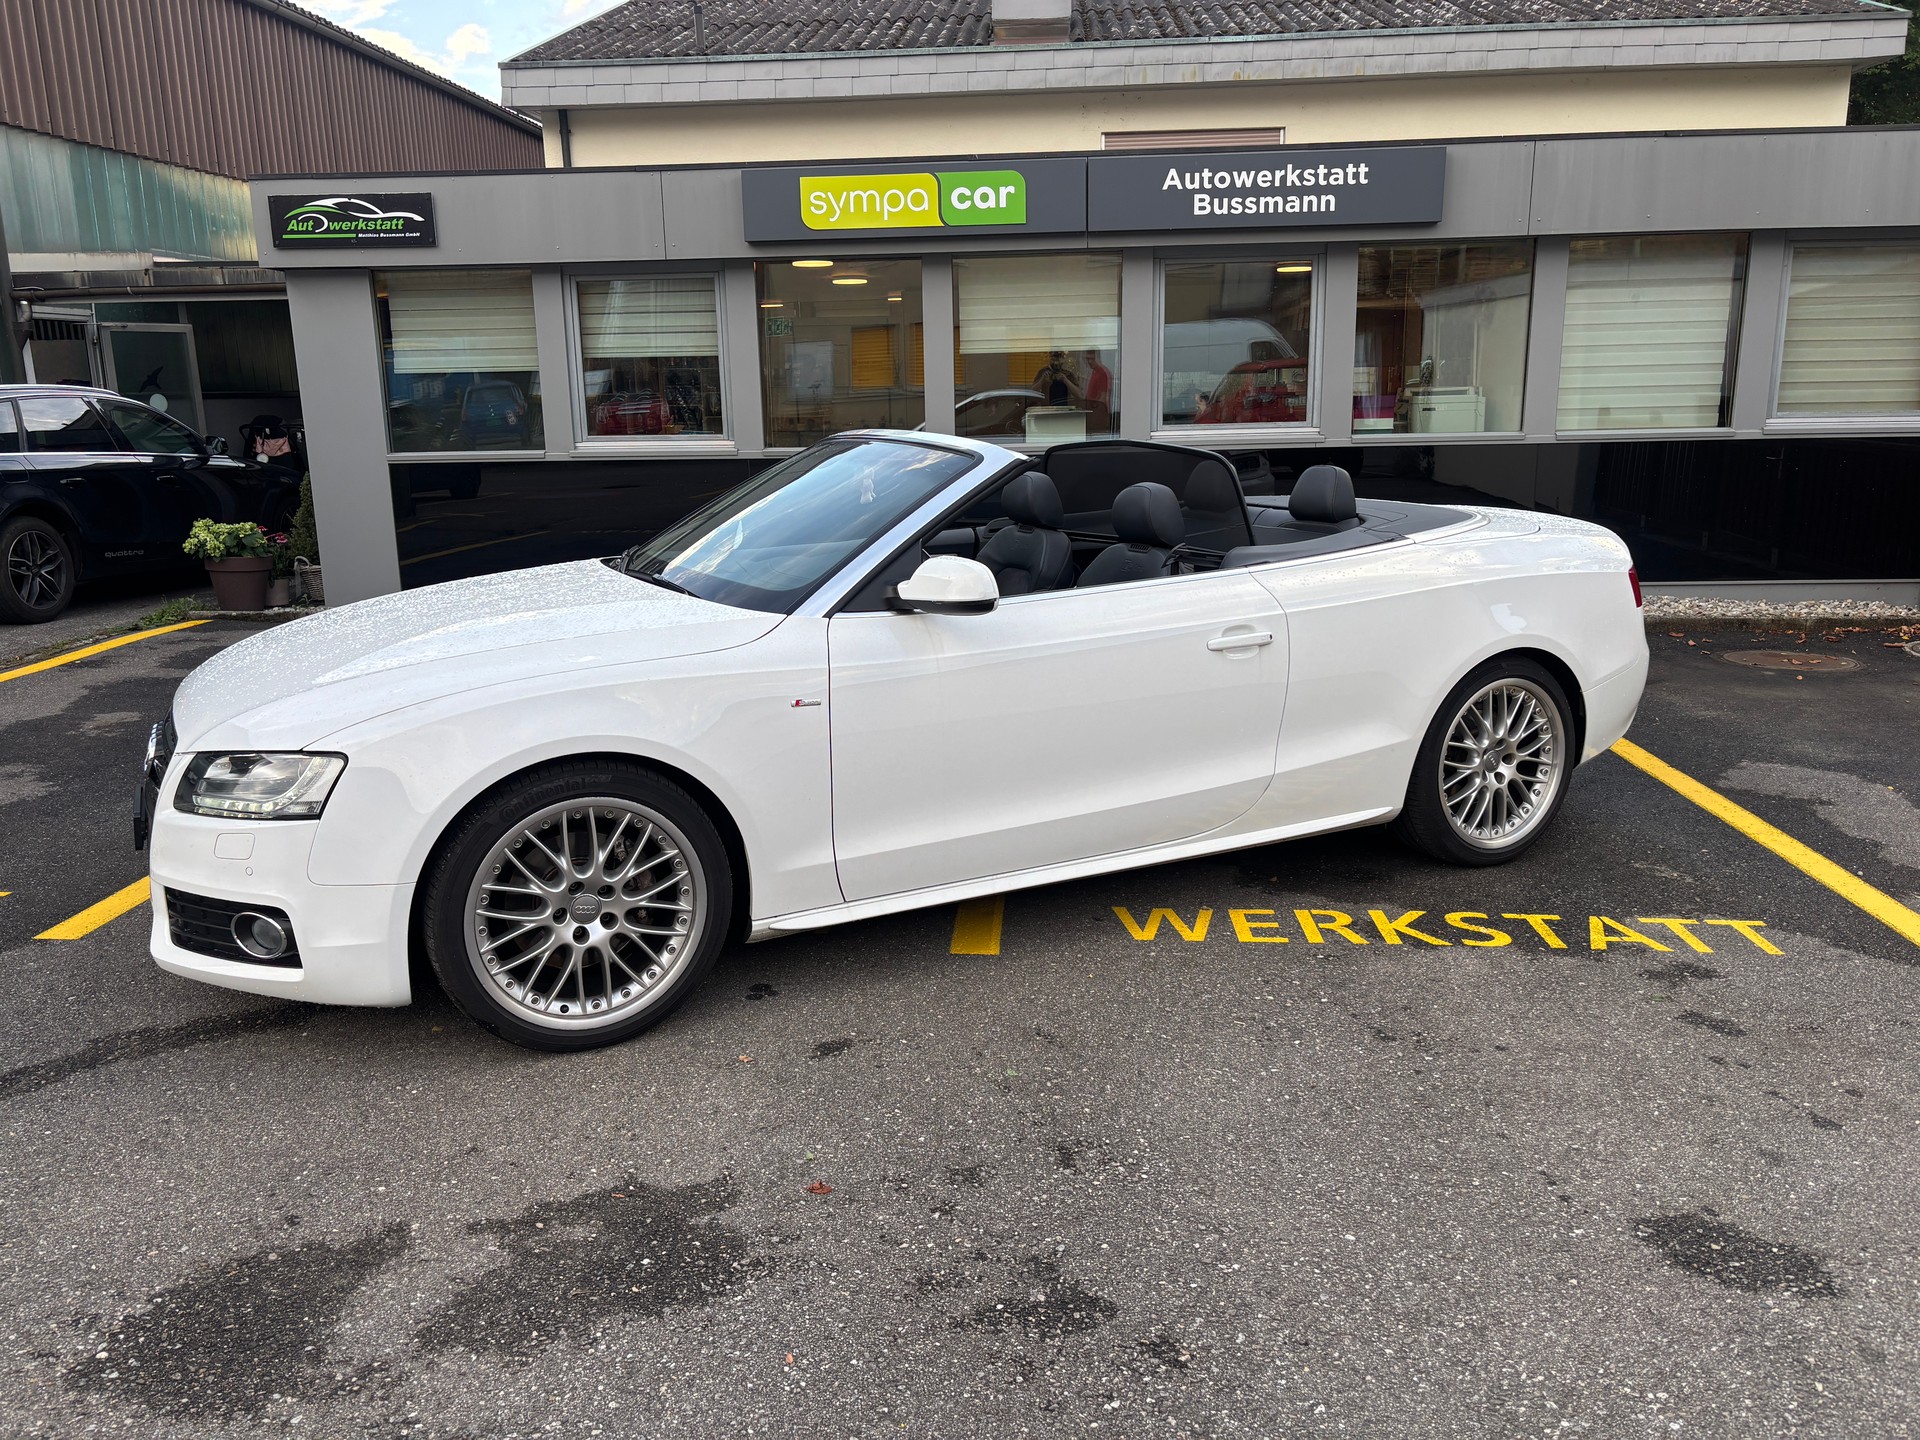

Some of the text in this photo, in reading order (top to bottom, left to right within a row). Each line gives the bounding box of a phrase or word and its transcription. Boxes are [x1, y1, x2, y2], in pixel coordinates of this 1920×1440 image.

[1161, 163, 1369, 190] Autowerkstatt
[809, 184, 1015, 222] sympa car
[1193, 193, 1336, 216] Bussmann
[104, 550, 145, 558] quattro
[1112, 906, 1786, 956] WERKSTATT
